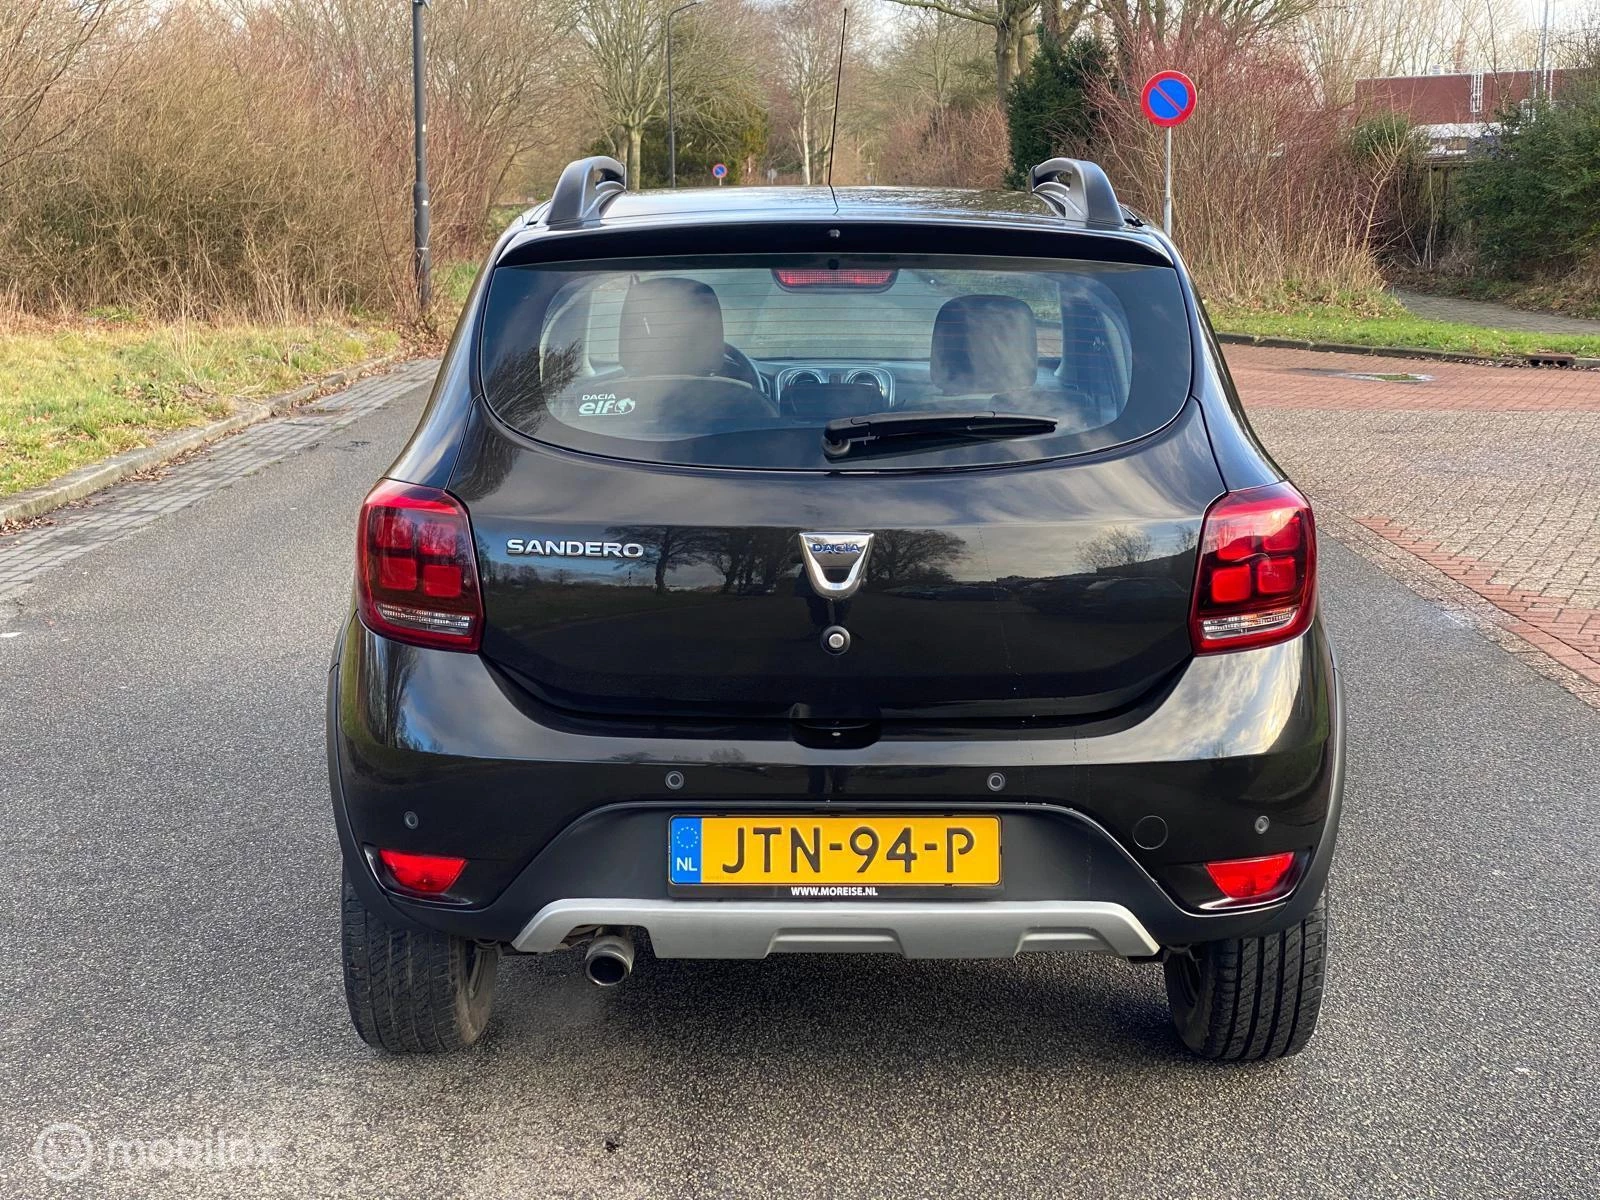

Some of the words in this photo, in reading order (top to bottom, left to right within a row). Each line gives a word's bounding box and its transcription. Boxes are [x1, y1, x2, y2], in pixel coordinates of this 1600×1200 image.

[579, 400, 615, 414] elf
[507, 539, 644, 558] SANDERO
[812, 543, 860, 553] DACIA
[722, 826, 975, 873] JTN-94-P
[676, 857, 698, 872] NL
[790, 886, 879, 897] WWW.MOREISE.NL
